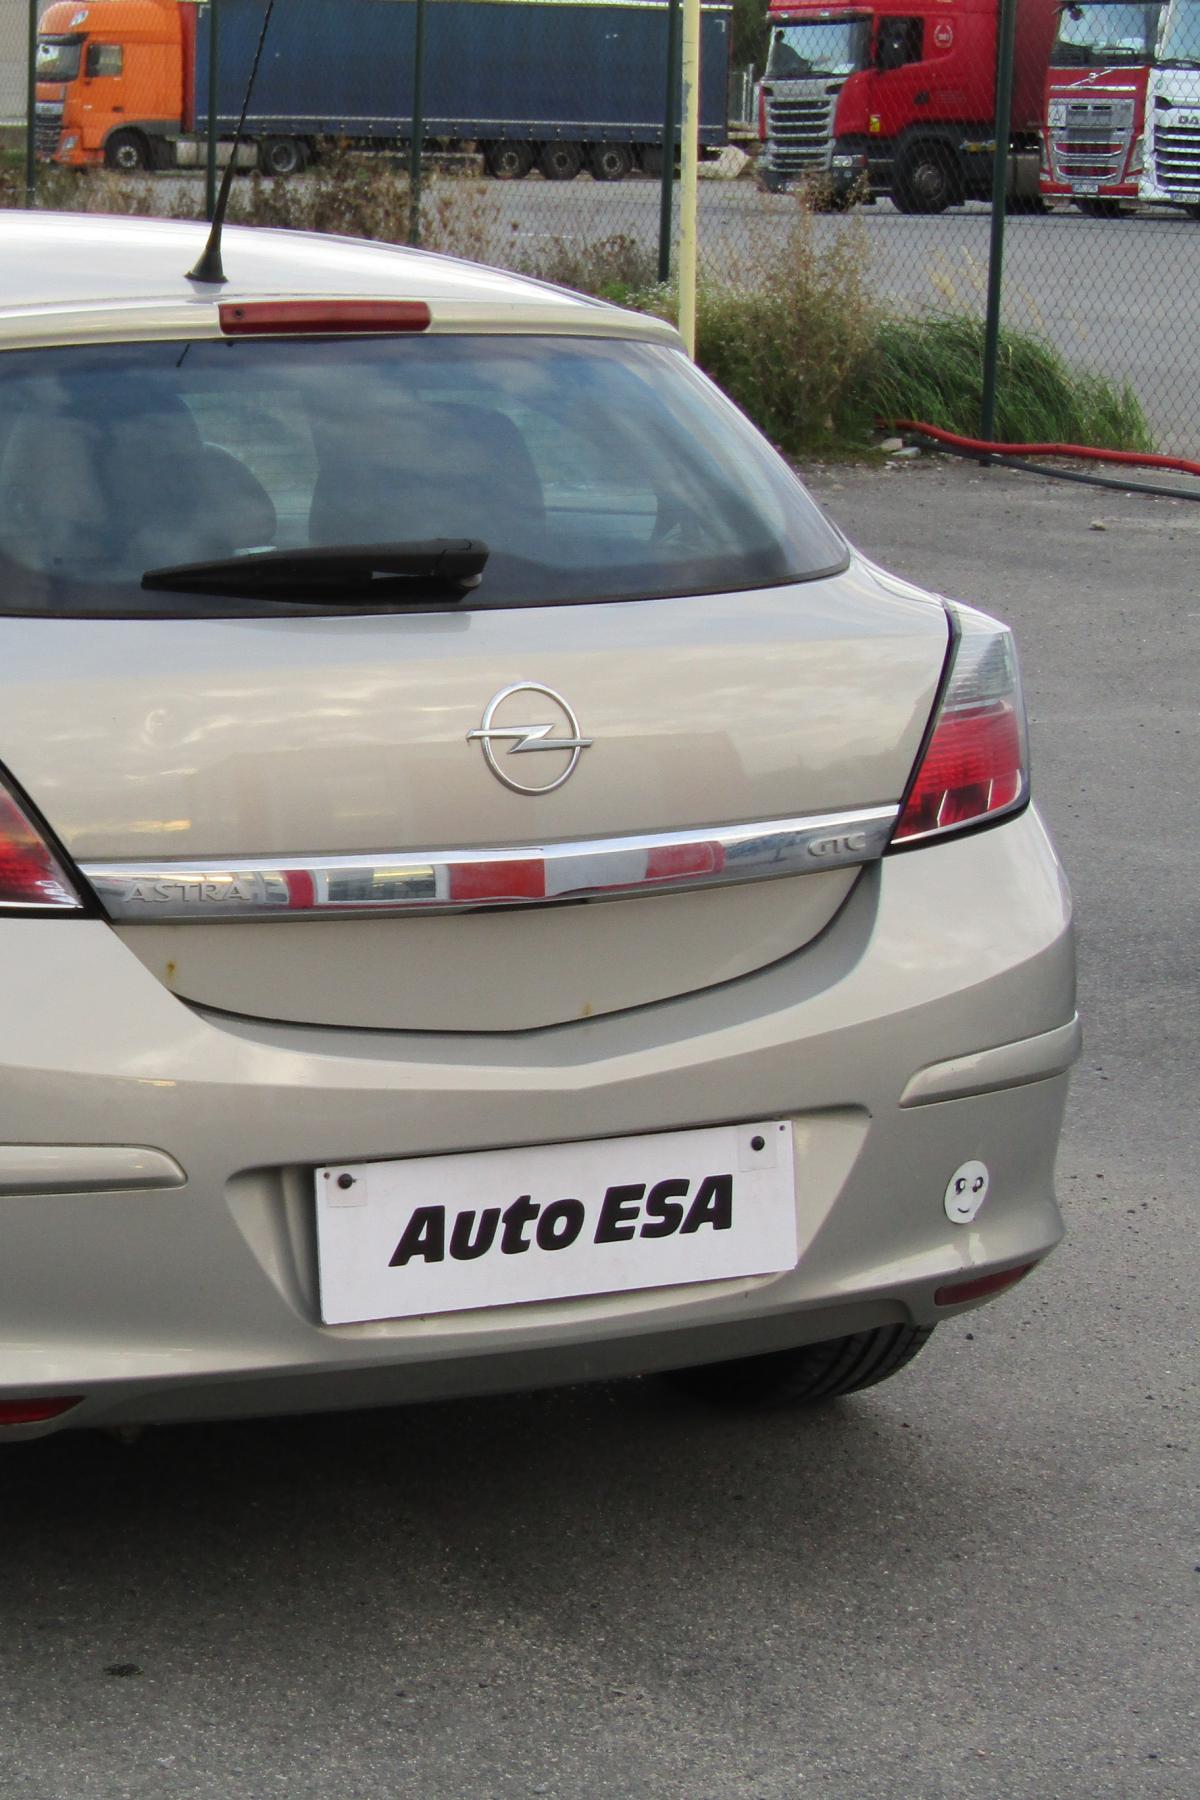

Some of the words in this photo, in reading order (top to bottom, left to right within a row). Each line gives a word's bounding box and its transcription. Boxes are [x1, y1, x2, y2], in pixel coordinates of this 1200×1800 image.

[808, 832, 866, 856] GTC
[121, 880, 251, 903] ASTRA
[388, 1195, 585, 1267] Auto
[594, 1174, 732, 1244] ESA
